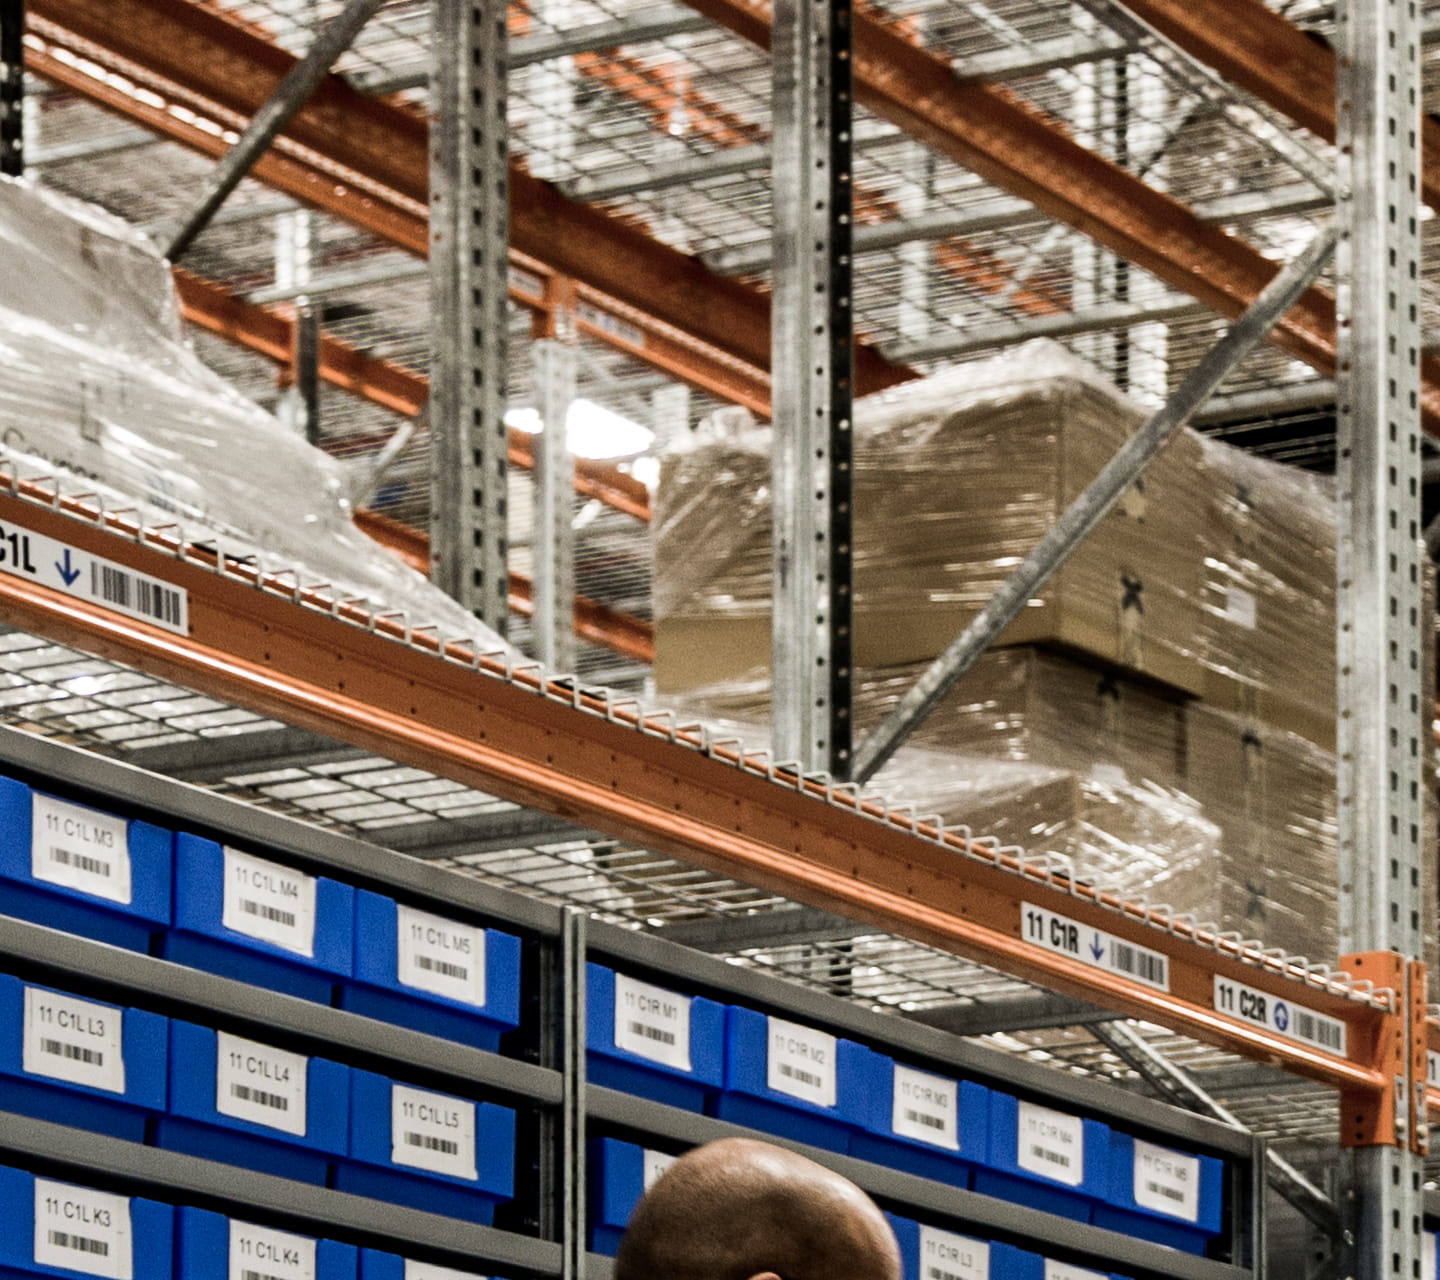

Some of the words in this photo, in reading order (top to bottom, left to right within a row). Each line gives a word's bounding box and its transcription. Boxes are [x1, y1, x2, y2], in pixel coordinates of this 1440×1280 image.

[1027, 911, 1043, 940] 11
[1050, 918, 1079, 954] C1R
[625, 991, 635, 1006] 11
[1219, 983, 1234, 1011] 11
[1239, 990, 1267, 1023] C2R
